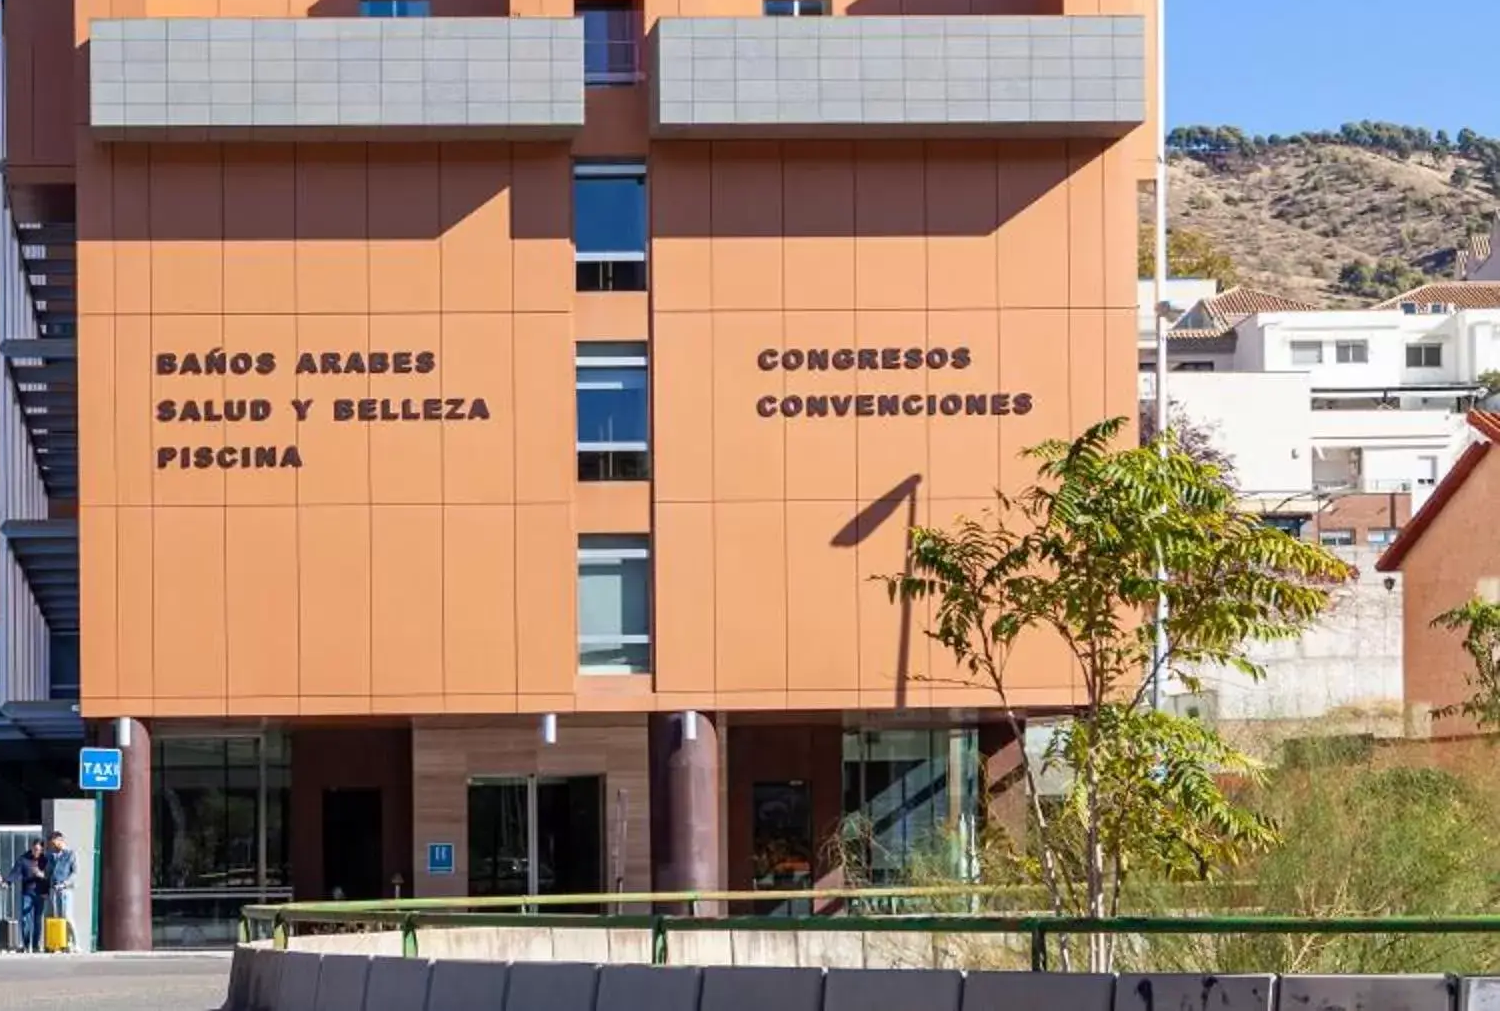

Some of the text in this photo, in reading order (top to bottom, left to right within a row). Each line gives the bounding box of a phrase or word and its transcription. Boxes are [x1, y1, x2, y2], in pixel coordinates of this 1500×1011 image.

[155, 347, 436, 375] BAÑOS ARABES
[757, 347, 971, 371] CONGRESOS
[156, 398, 490, 422] SALUD Y BELLEZA
[756, 393, 1033, 418] CONVENCIONES
[157, 446, 303, 469] PISCINA
[83, 762, 118, 776] TAXI
